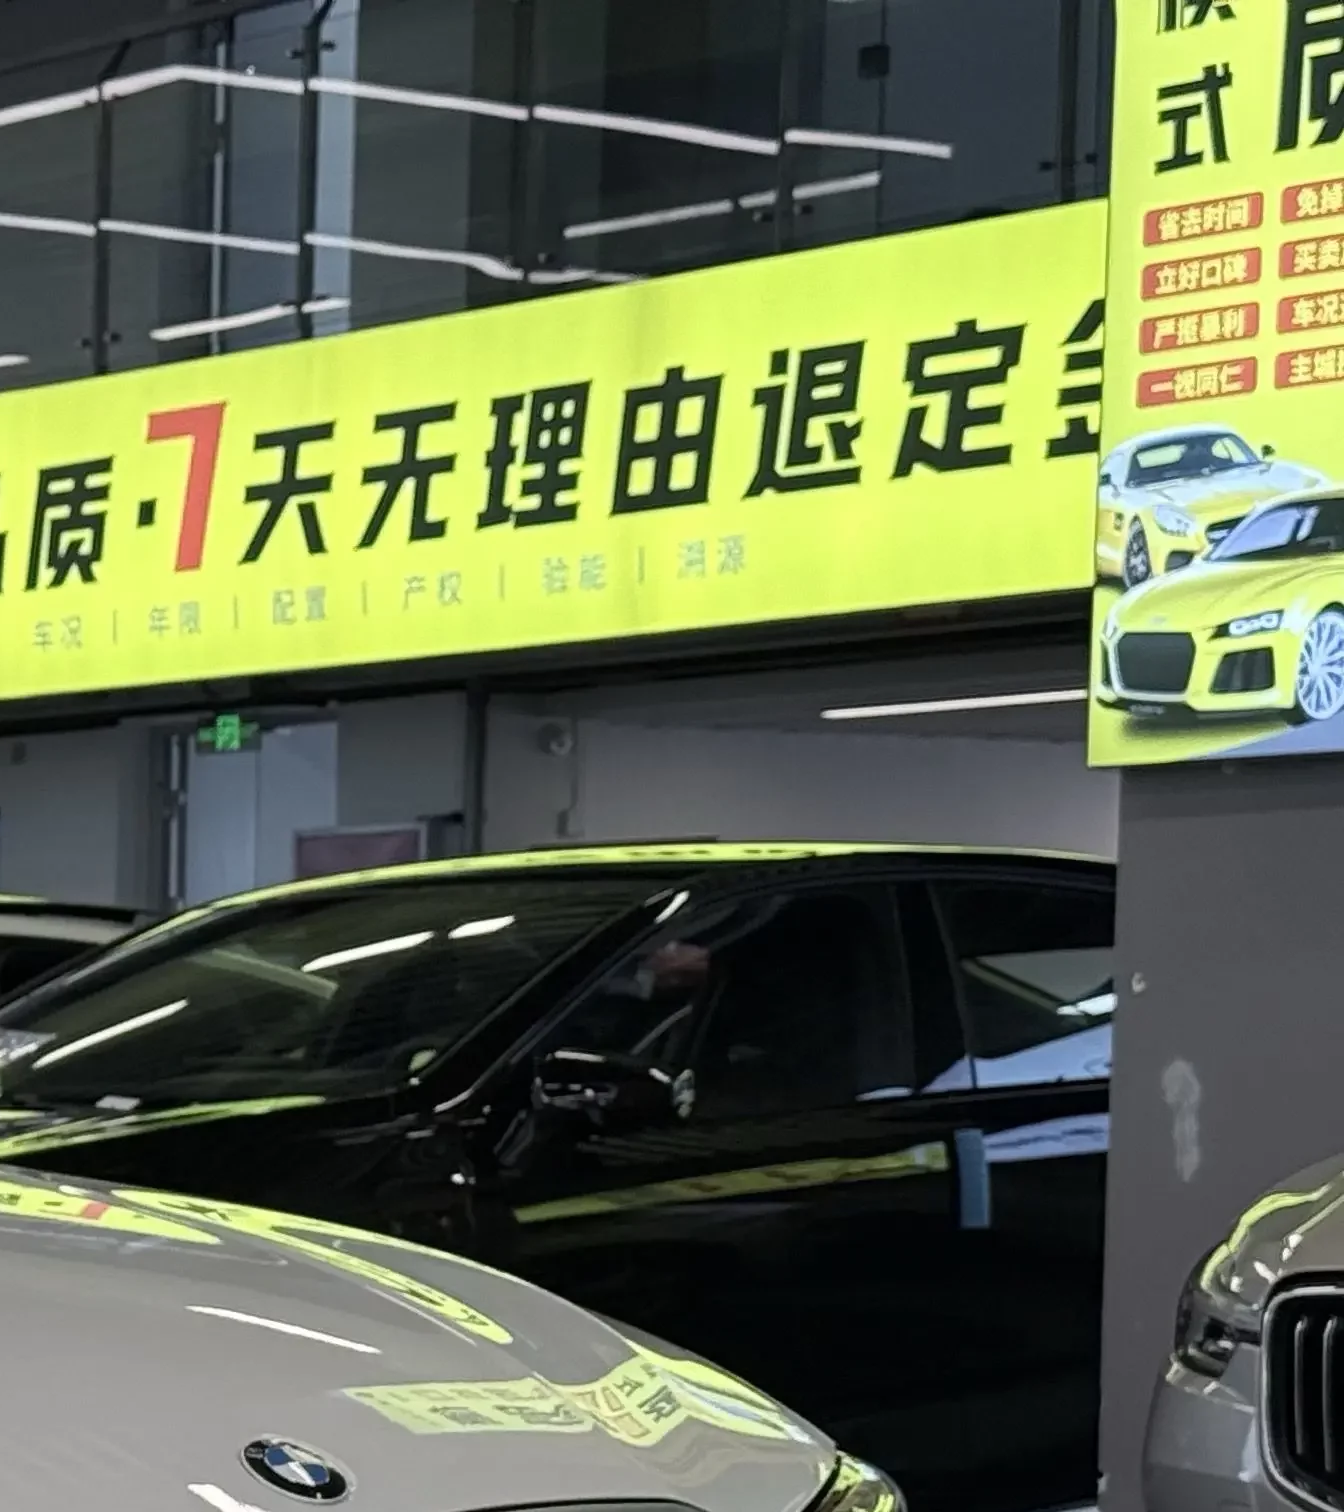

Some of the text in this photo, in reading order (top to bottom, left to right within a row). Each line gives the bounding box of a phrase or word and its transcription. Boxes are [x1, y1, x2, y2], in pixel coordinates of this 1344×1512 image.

[1292, 236, 1344, 274] 买卖
[1291, 292, 1344, 329] 车况
[402, 571, 464, 612] 产权
